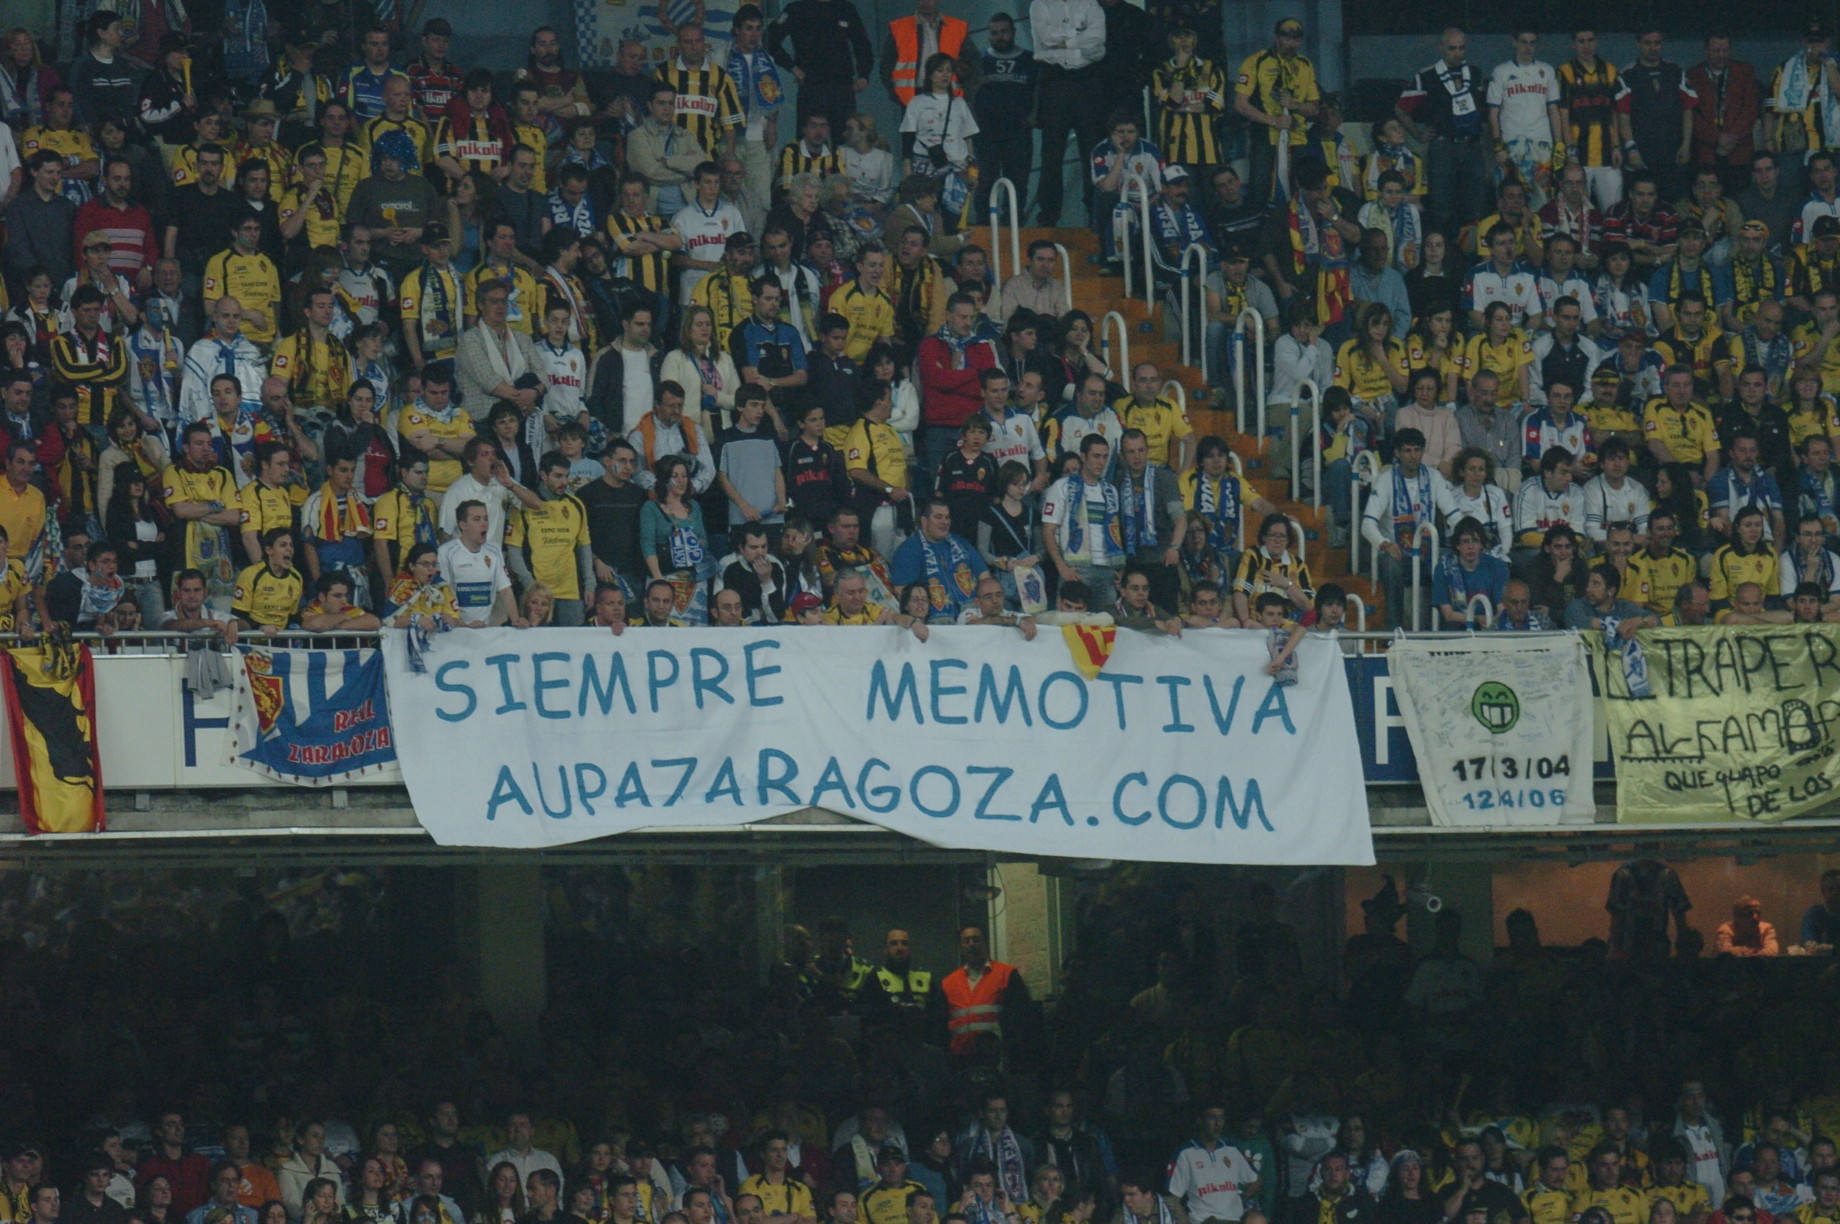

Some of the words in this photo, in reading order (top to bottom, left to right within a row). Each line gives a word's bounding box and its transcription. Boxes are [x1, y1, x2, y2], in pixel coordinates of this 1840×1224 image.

[435, 639, 784, 723] SIEMPRE
[867, 658, 1297, 736] MEMOTIVA
[1746, 788, 1781, 818] DE
[1789, 772, 1833, 802] LOS
